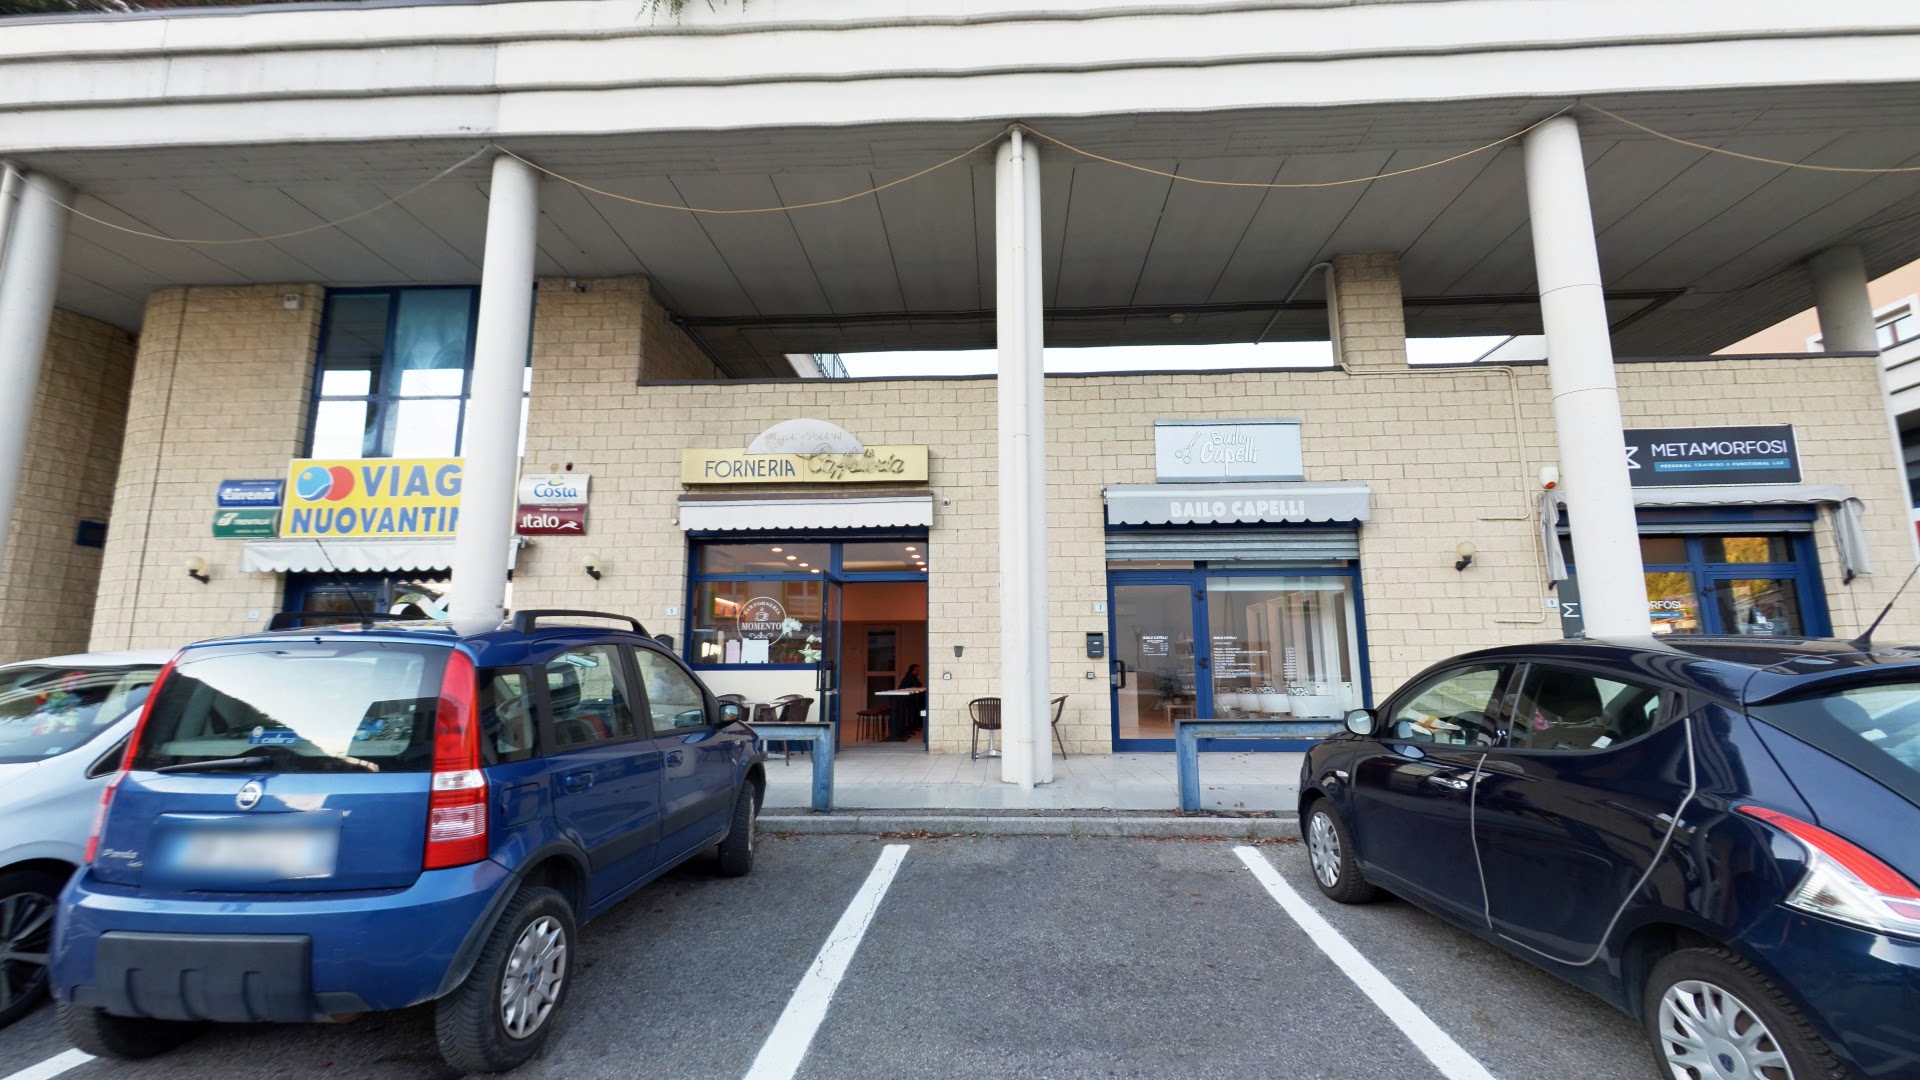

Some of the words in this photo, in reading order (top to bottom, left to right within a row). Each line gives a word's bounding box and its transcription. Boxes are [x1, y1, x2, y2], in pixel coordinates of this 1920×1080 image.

[1211, 425, 1246, 445] Bailo
[1200, 438, 1258, 476] Capelli
[1651, 440, 1788, 457] METAMORFOSI
[705, 459, 796, 478] FORNERIA
[361, 464, 463, 497] VIAG
[533, 483, 578, 498] Costa
[1170, 501, 1227, 518] BAILO
[1231, 499, 1305, 517] CAPELLI
[743, 604, 754, 616] BAR
[753, 601, 781, 615] FORNERIA
[741, 621, 783, 631] MOMENTO
[261, 733, 296, 744] cobra
